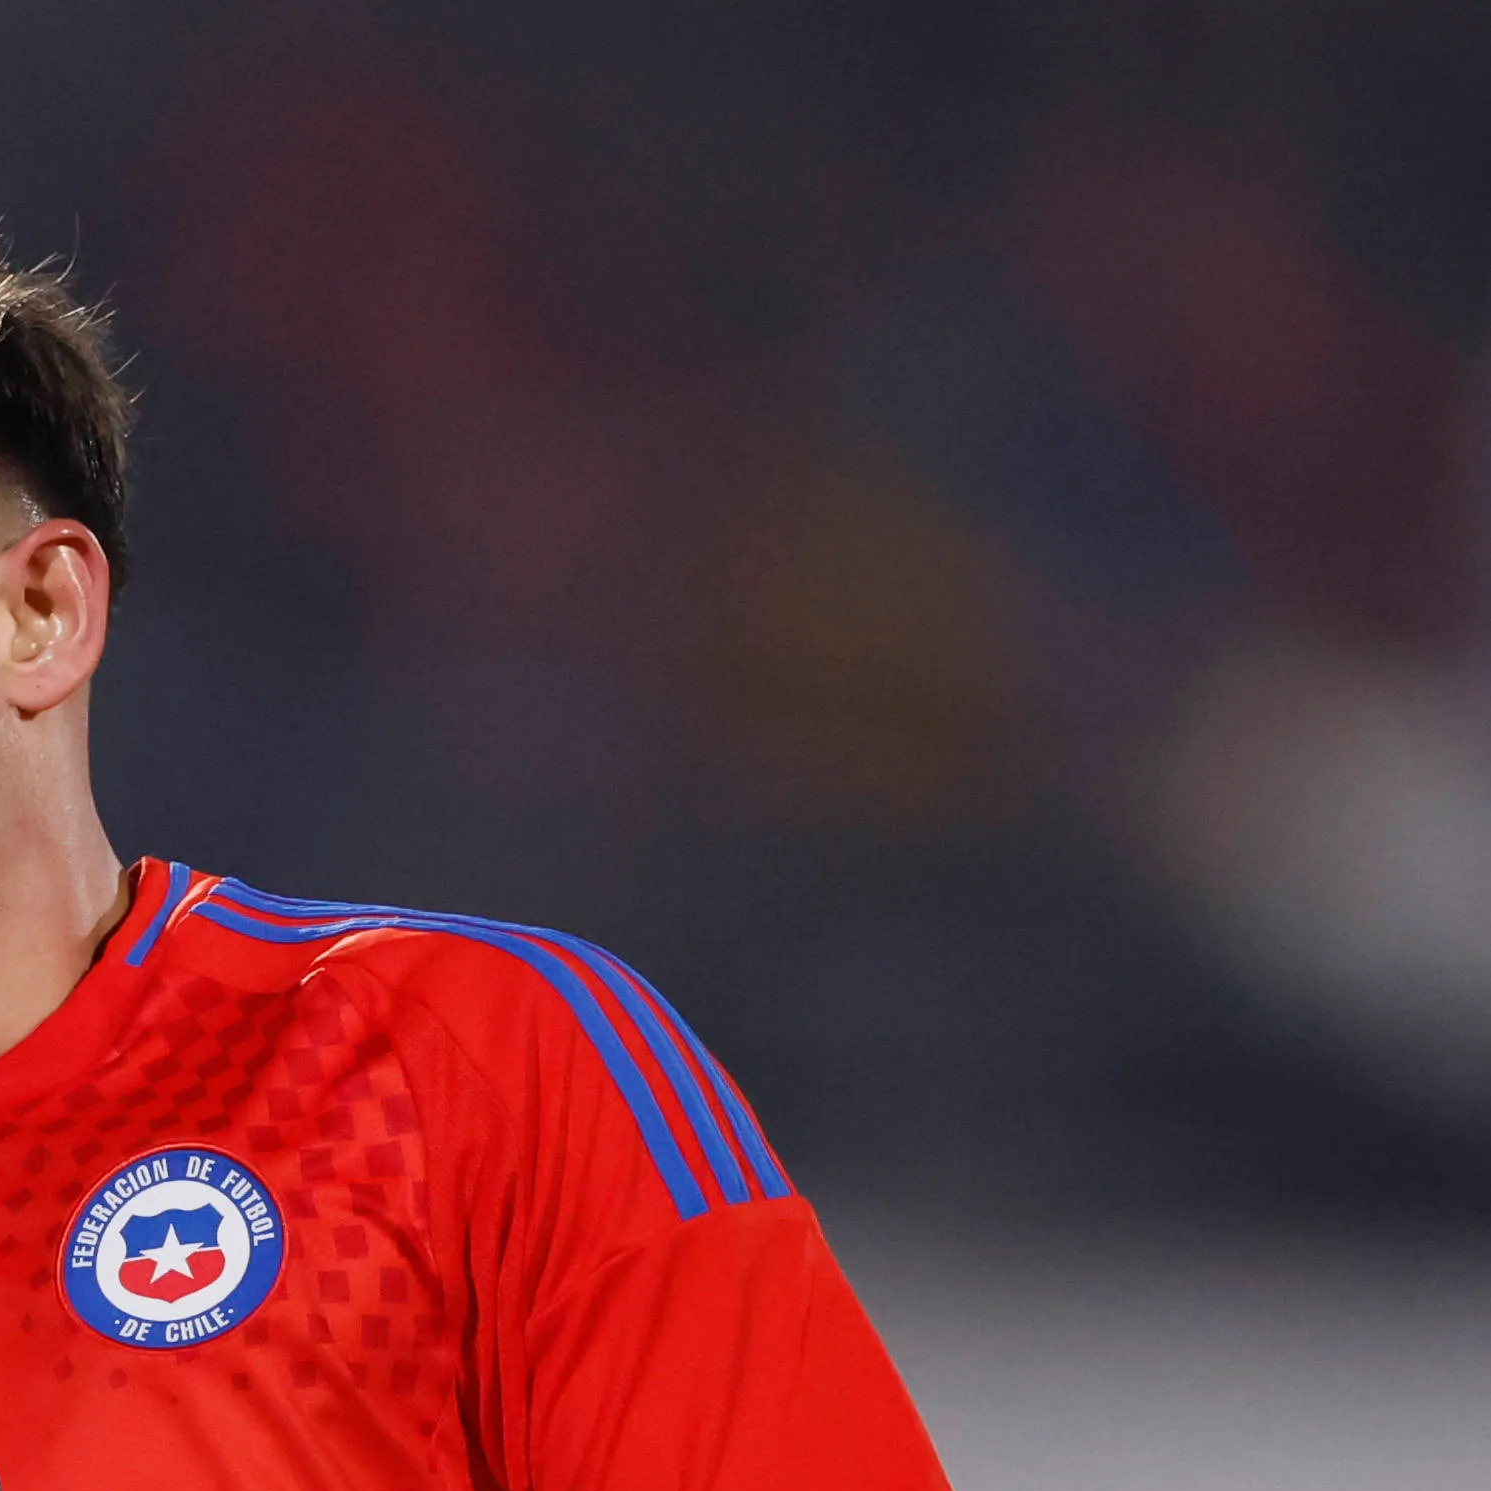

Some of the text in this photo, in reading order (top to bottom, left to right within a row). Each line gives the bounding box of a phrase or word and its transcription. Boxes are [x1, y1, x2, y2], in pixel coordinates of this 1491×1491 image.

[71, 1155, 275, 1268] FEDERACION DE FUTBOL
[119, 1306, 231, 1343] DE CHILE
